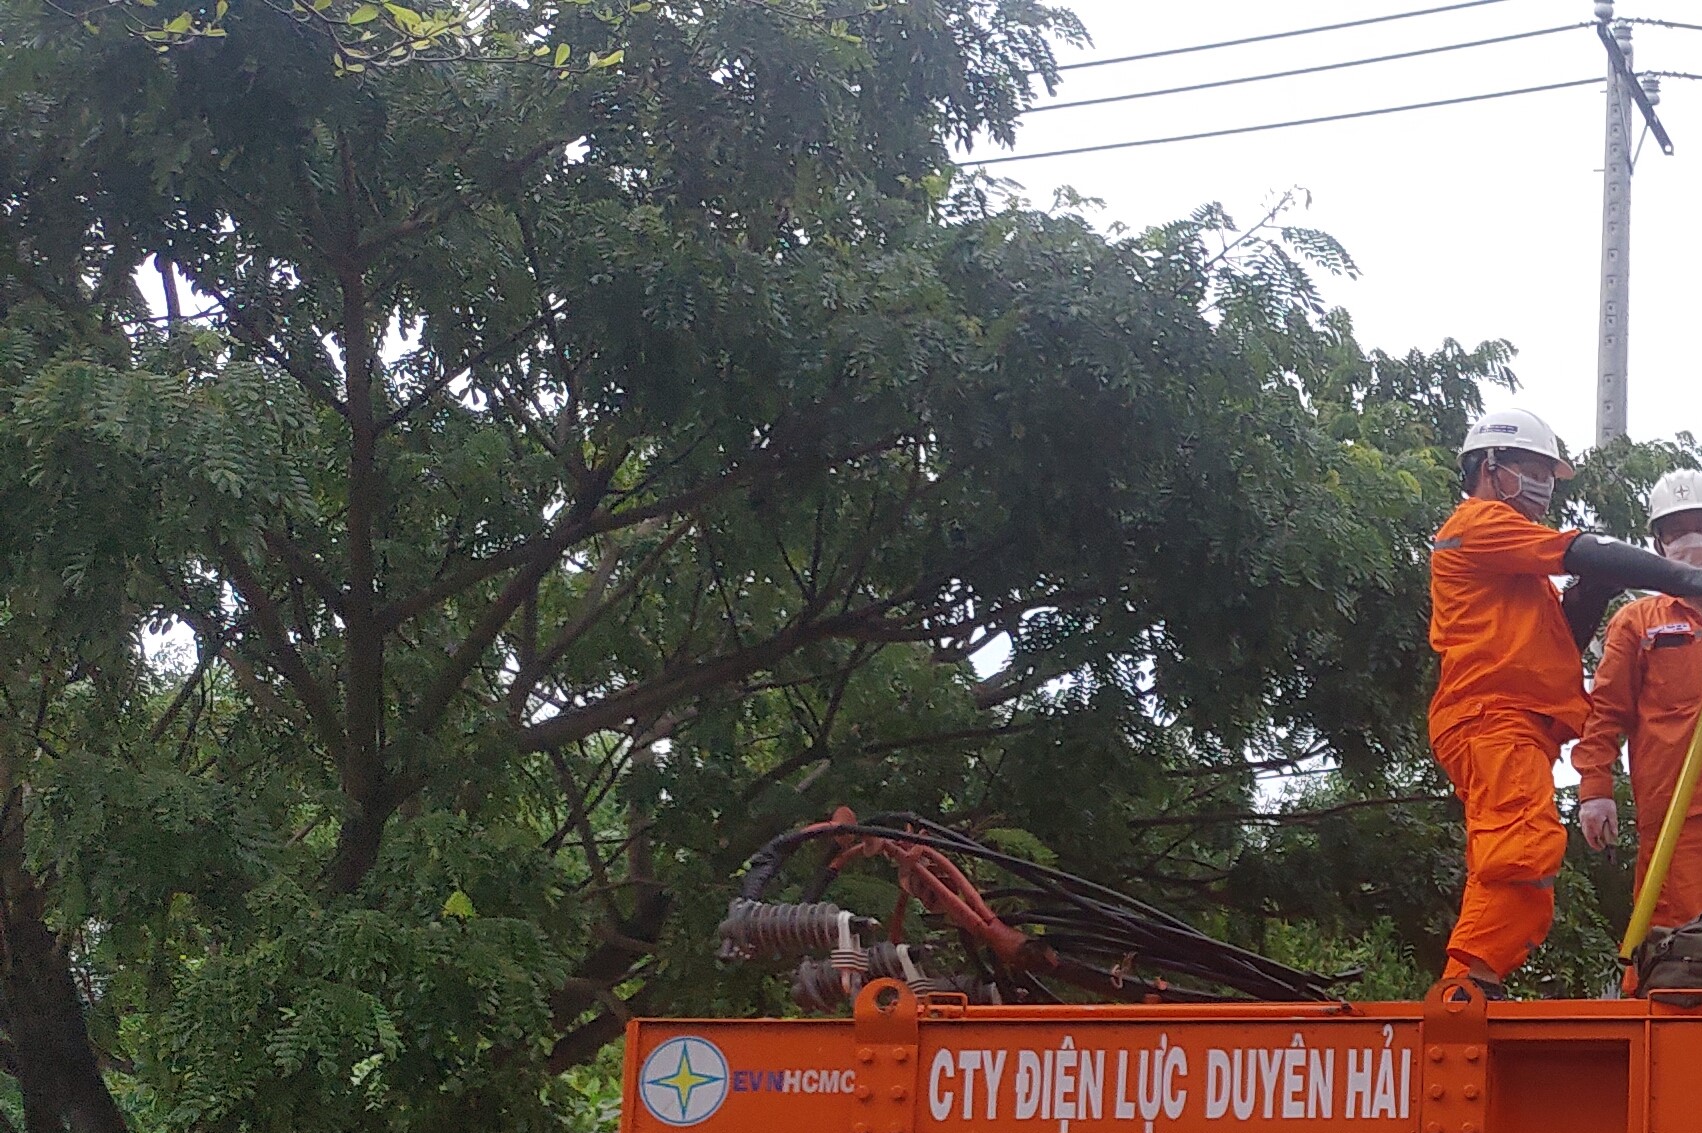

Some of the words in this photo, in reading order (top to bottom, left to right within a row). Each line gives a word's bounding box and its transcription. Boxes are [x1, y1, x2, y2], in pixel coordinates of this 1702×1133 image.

[929, 1047, 1007, 1122] CTY
[1205, 1032, 1335, 1121] DUYÊN
[1345, 1023, 1412, 1119] HẢI
